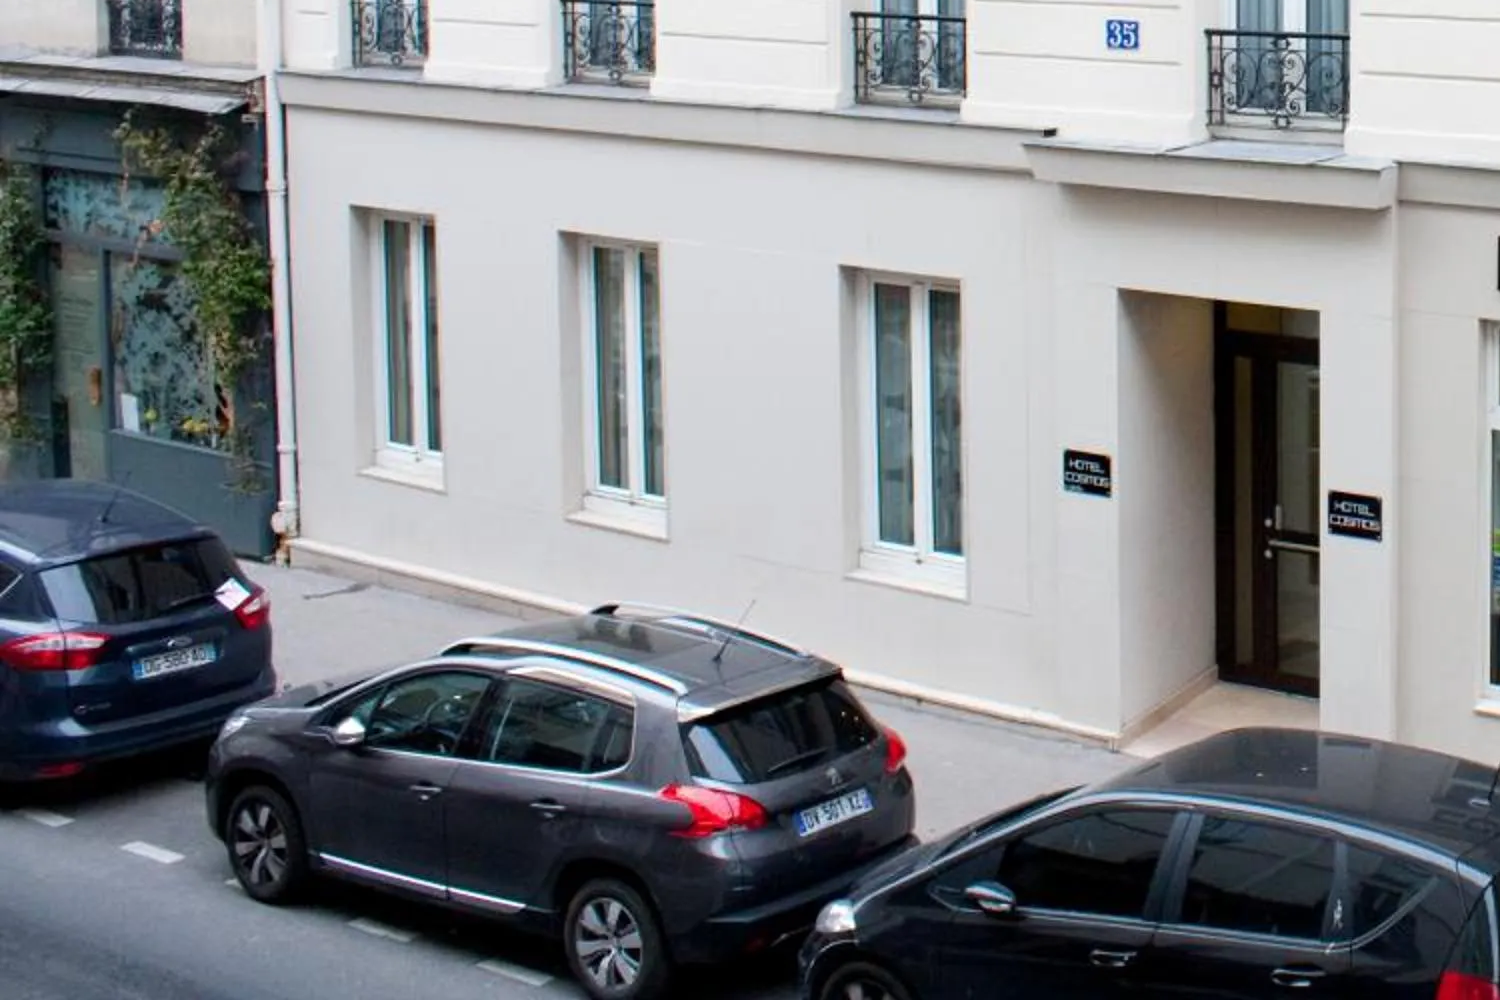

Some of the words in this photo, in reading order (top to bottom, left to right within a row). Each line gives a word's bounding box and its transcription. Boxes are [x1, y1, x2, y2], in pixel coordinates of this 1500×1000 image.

[1109, 21, 1136, 48] 35
[1069, 458, 1105, 474] HOTEL
[1065, 471, 1110, 489] COSMOS
[1334, 500, 1376, 517] HOTEL
[1330, 514, 1380, 531] COSMOS
